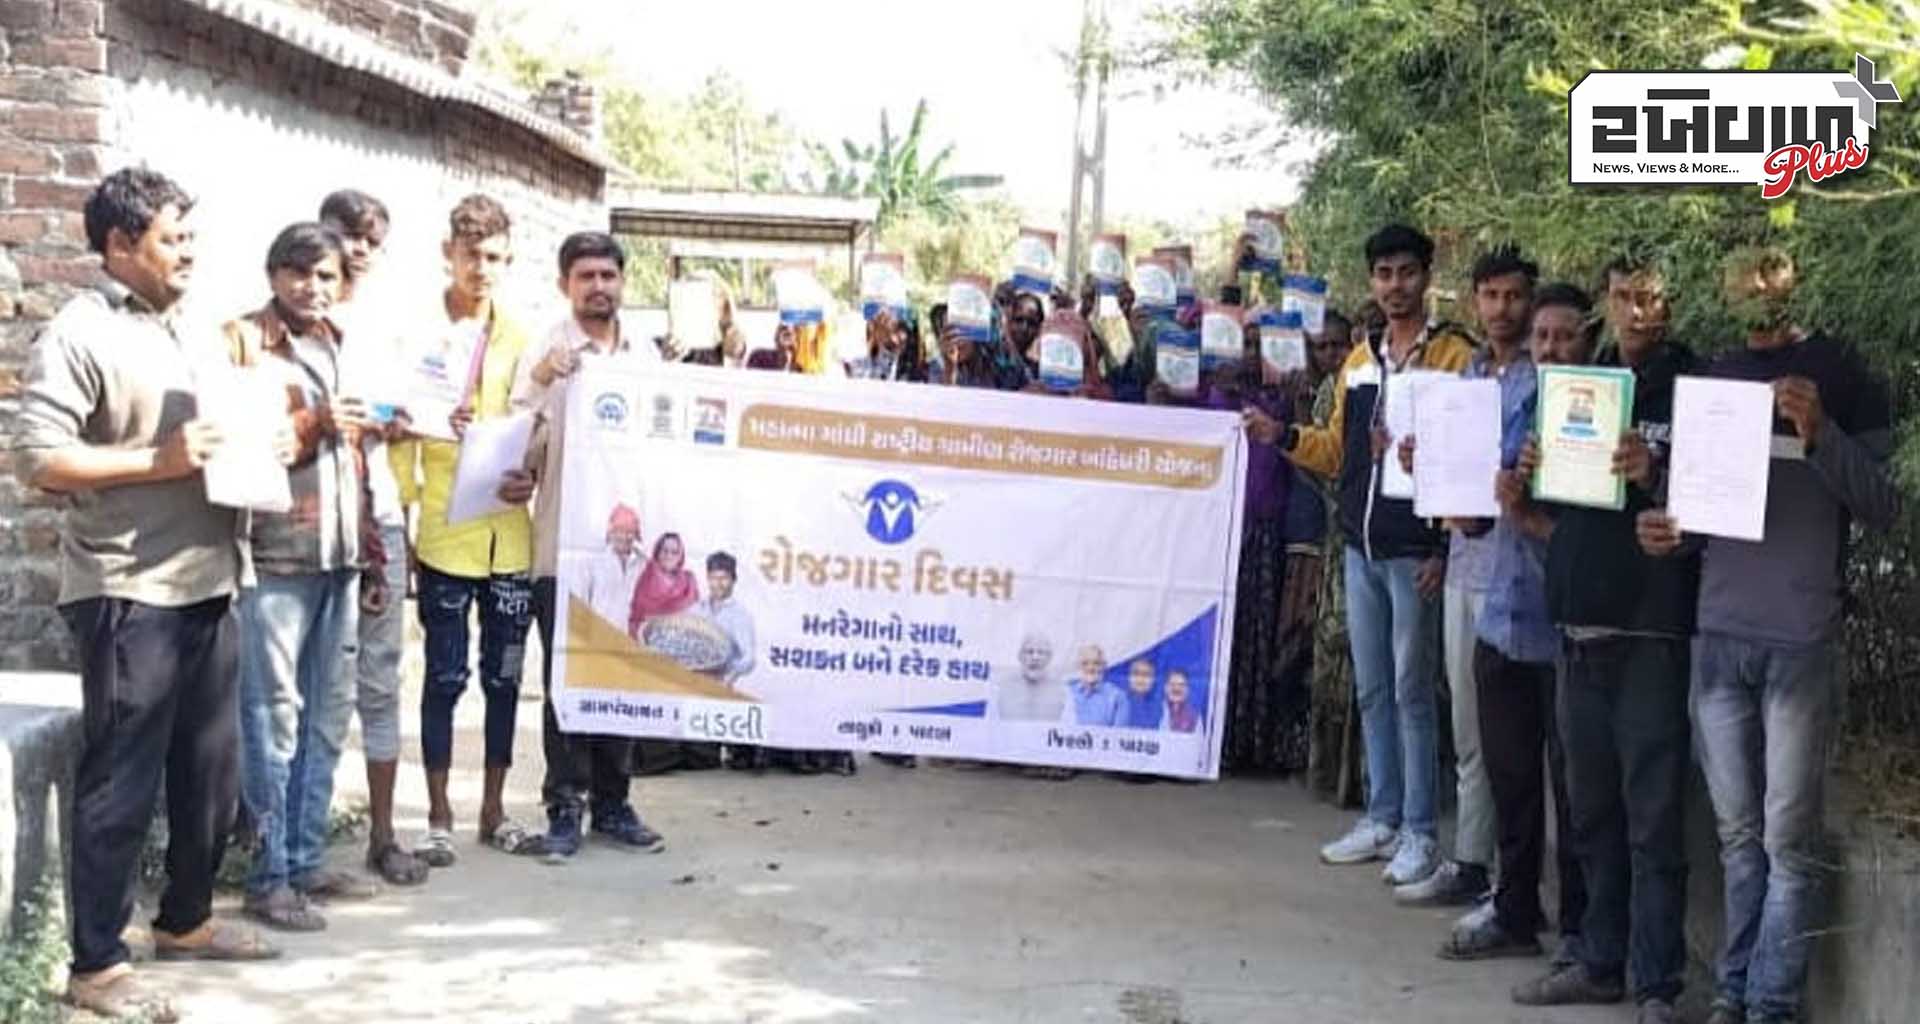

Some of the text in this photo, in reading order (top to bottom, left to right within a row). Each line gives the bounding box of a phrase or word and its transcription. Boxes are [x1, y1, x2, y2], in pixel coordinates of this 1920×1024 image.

[758, 535, 1014, 600] રોજગાર દિવસ
[801, 608, 963, 649] મનરેગાનો સાથ,
[770, 645, 991, 681] સશક્ત બને દરેક હાથ
[689, 704, 764, 738] વડલી
